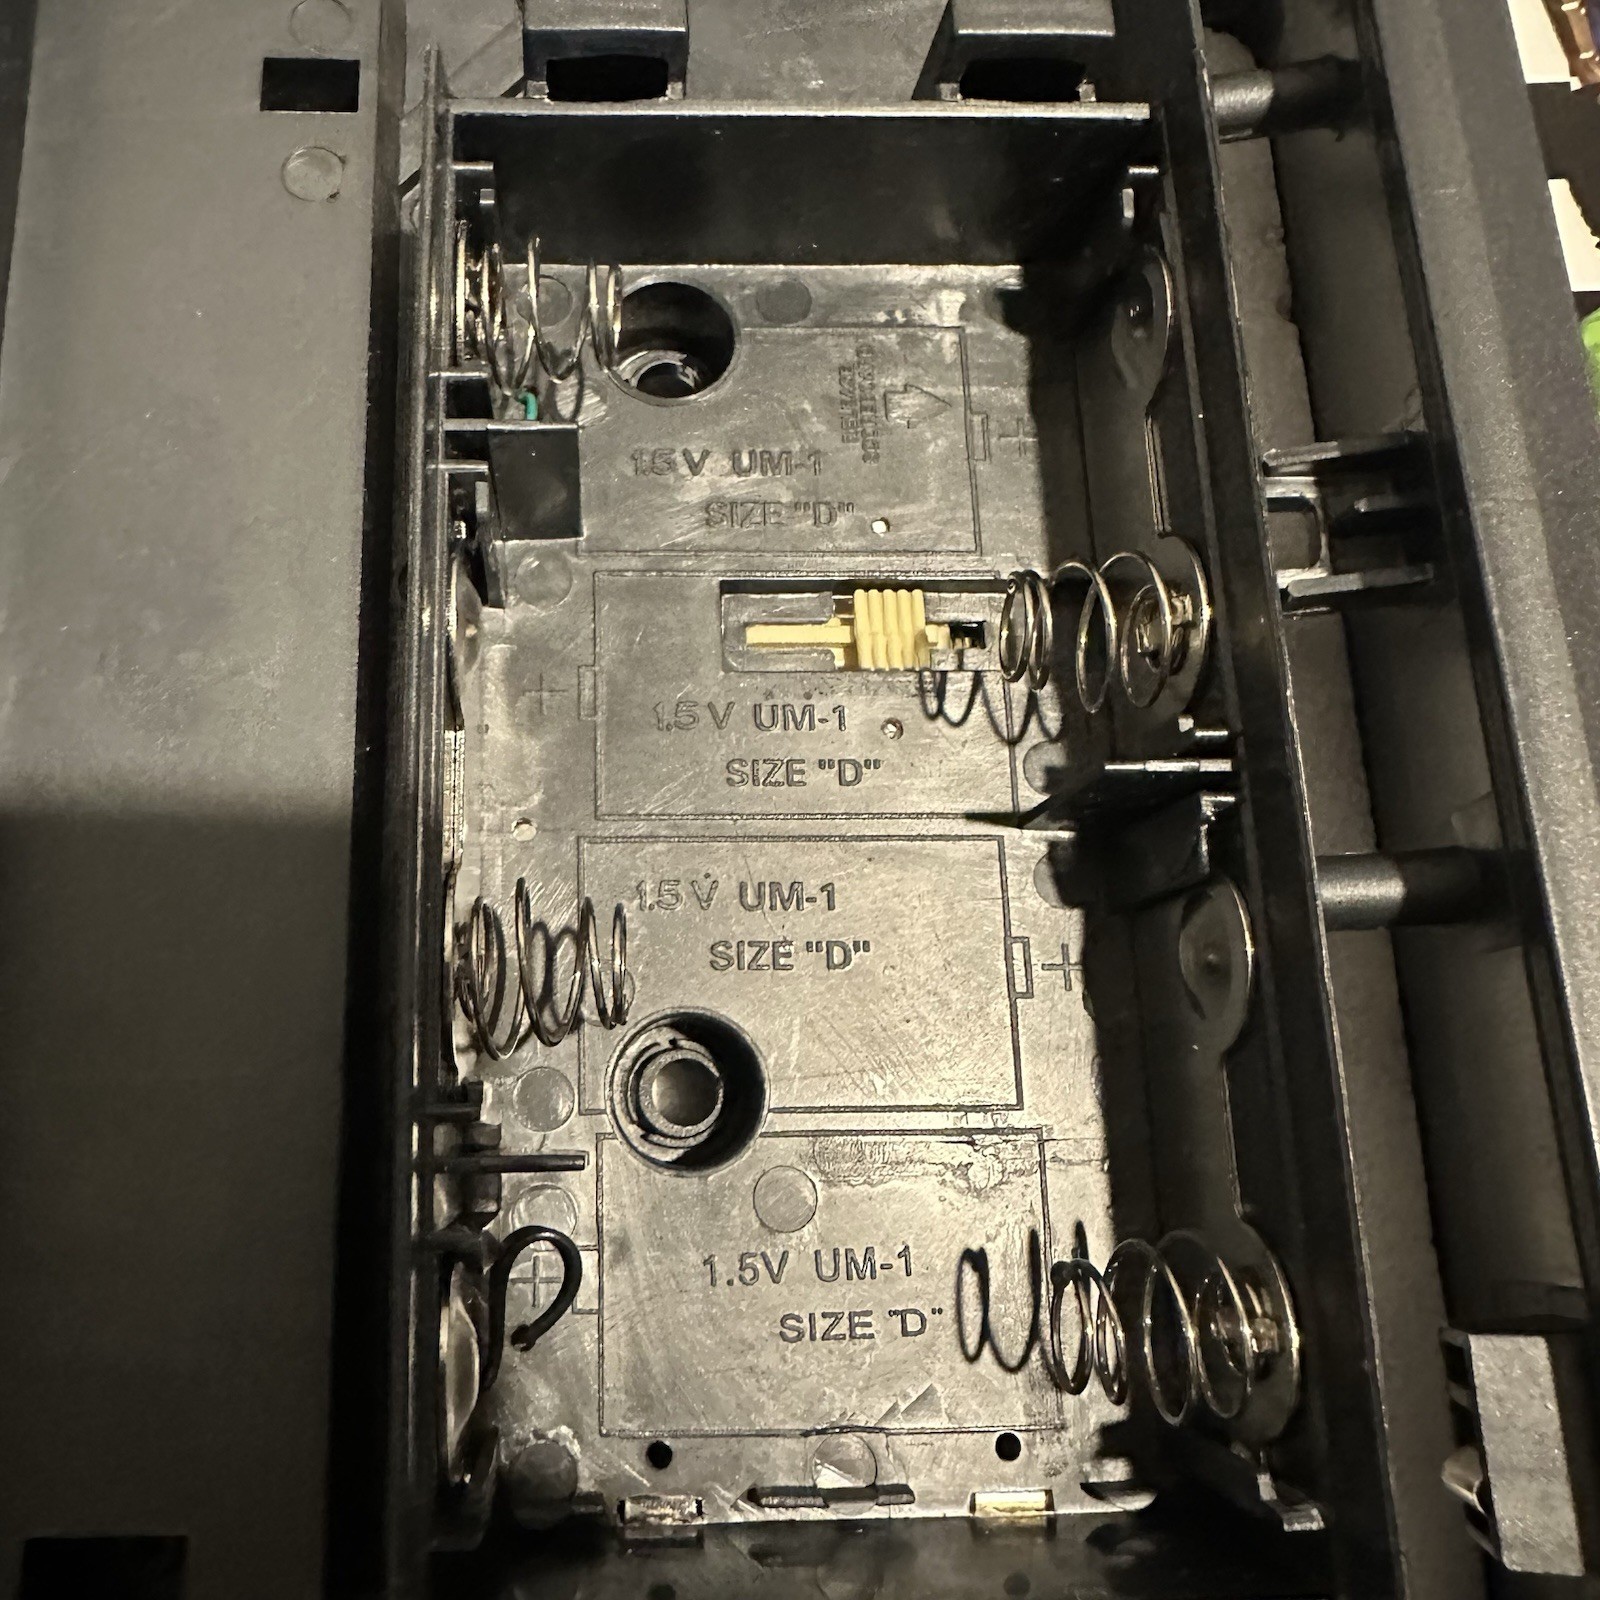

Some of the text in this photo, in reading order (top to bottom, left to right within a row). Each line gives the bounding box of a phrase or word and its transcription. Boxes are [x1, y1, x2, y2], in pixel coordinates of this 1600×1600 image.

[731, 448, 823, 477] UM-1
[703, 500, 856, 528] SIZE "D"
[753, 702, 848, 733] UM-1
[725, 757, 883, 788] SIZE "D"
[738, 880, 838, 912] UM-1
[708, 938, 872, 972] SIZE "D"
[702, 1244, 914, 1288] 1.5V UM-1
[778, 1305, 944, 1344] SIZE "D"
